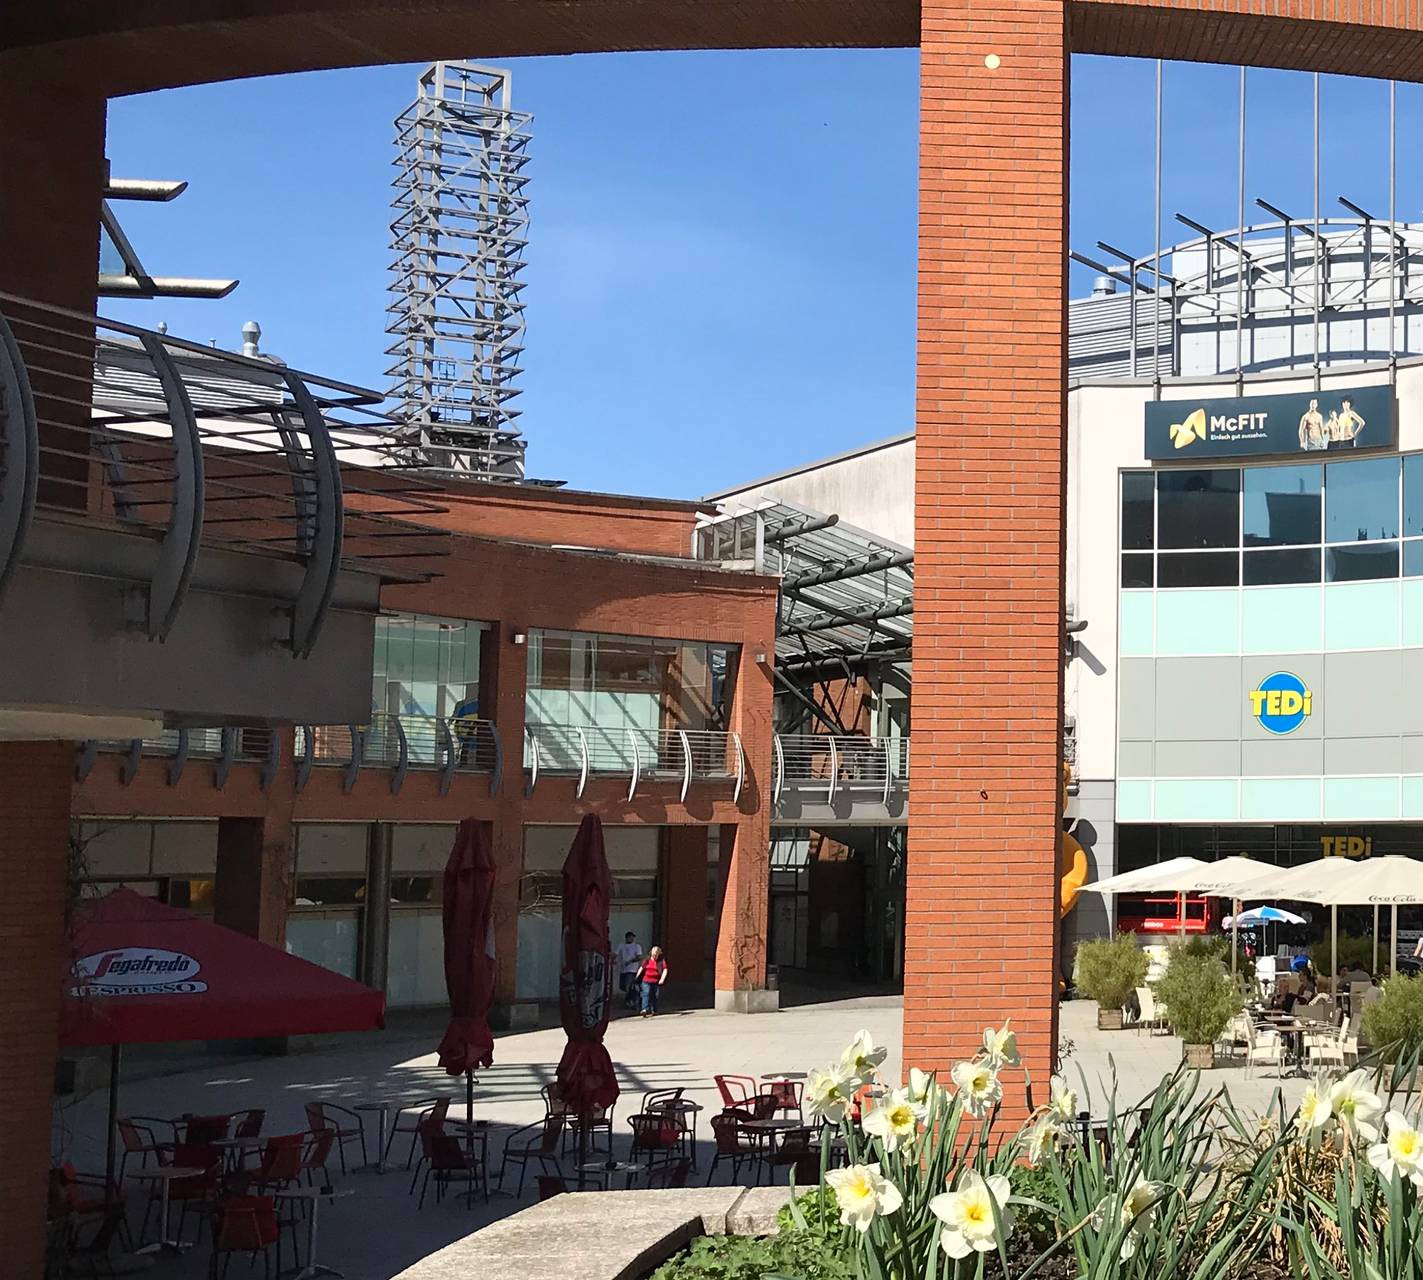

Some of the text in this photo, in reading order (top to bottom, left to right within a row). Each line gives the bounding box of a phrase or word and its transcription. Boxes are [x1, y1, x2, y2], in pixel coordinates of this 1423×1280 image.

[1210, 413, 1268, 432] McFIT
[1249, 690, 1312, 717] TEDi
[1321, 836, 1372, 858] TEDi
[84, 952, 190, 978] Segafredo
